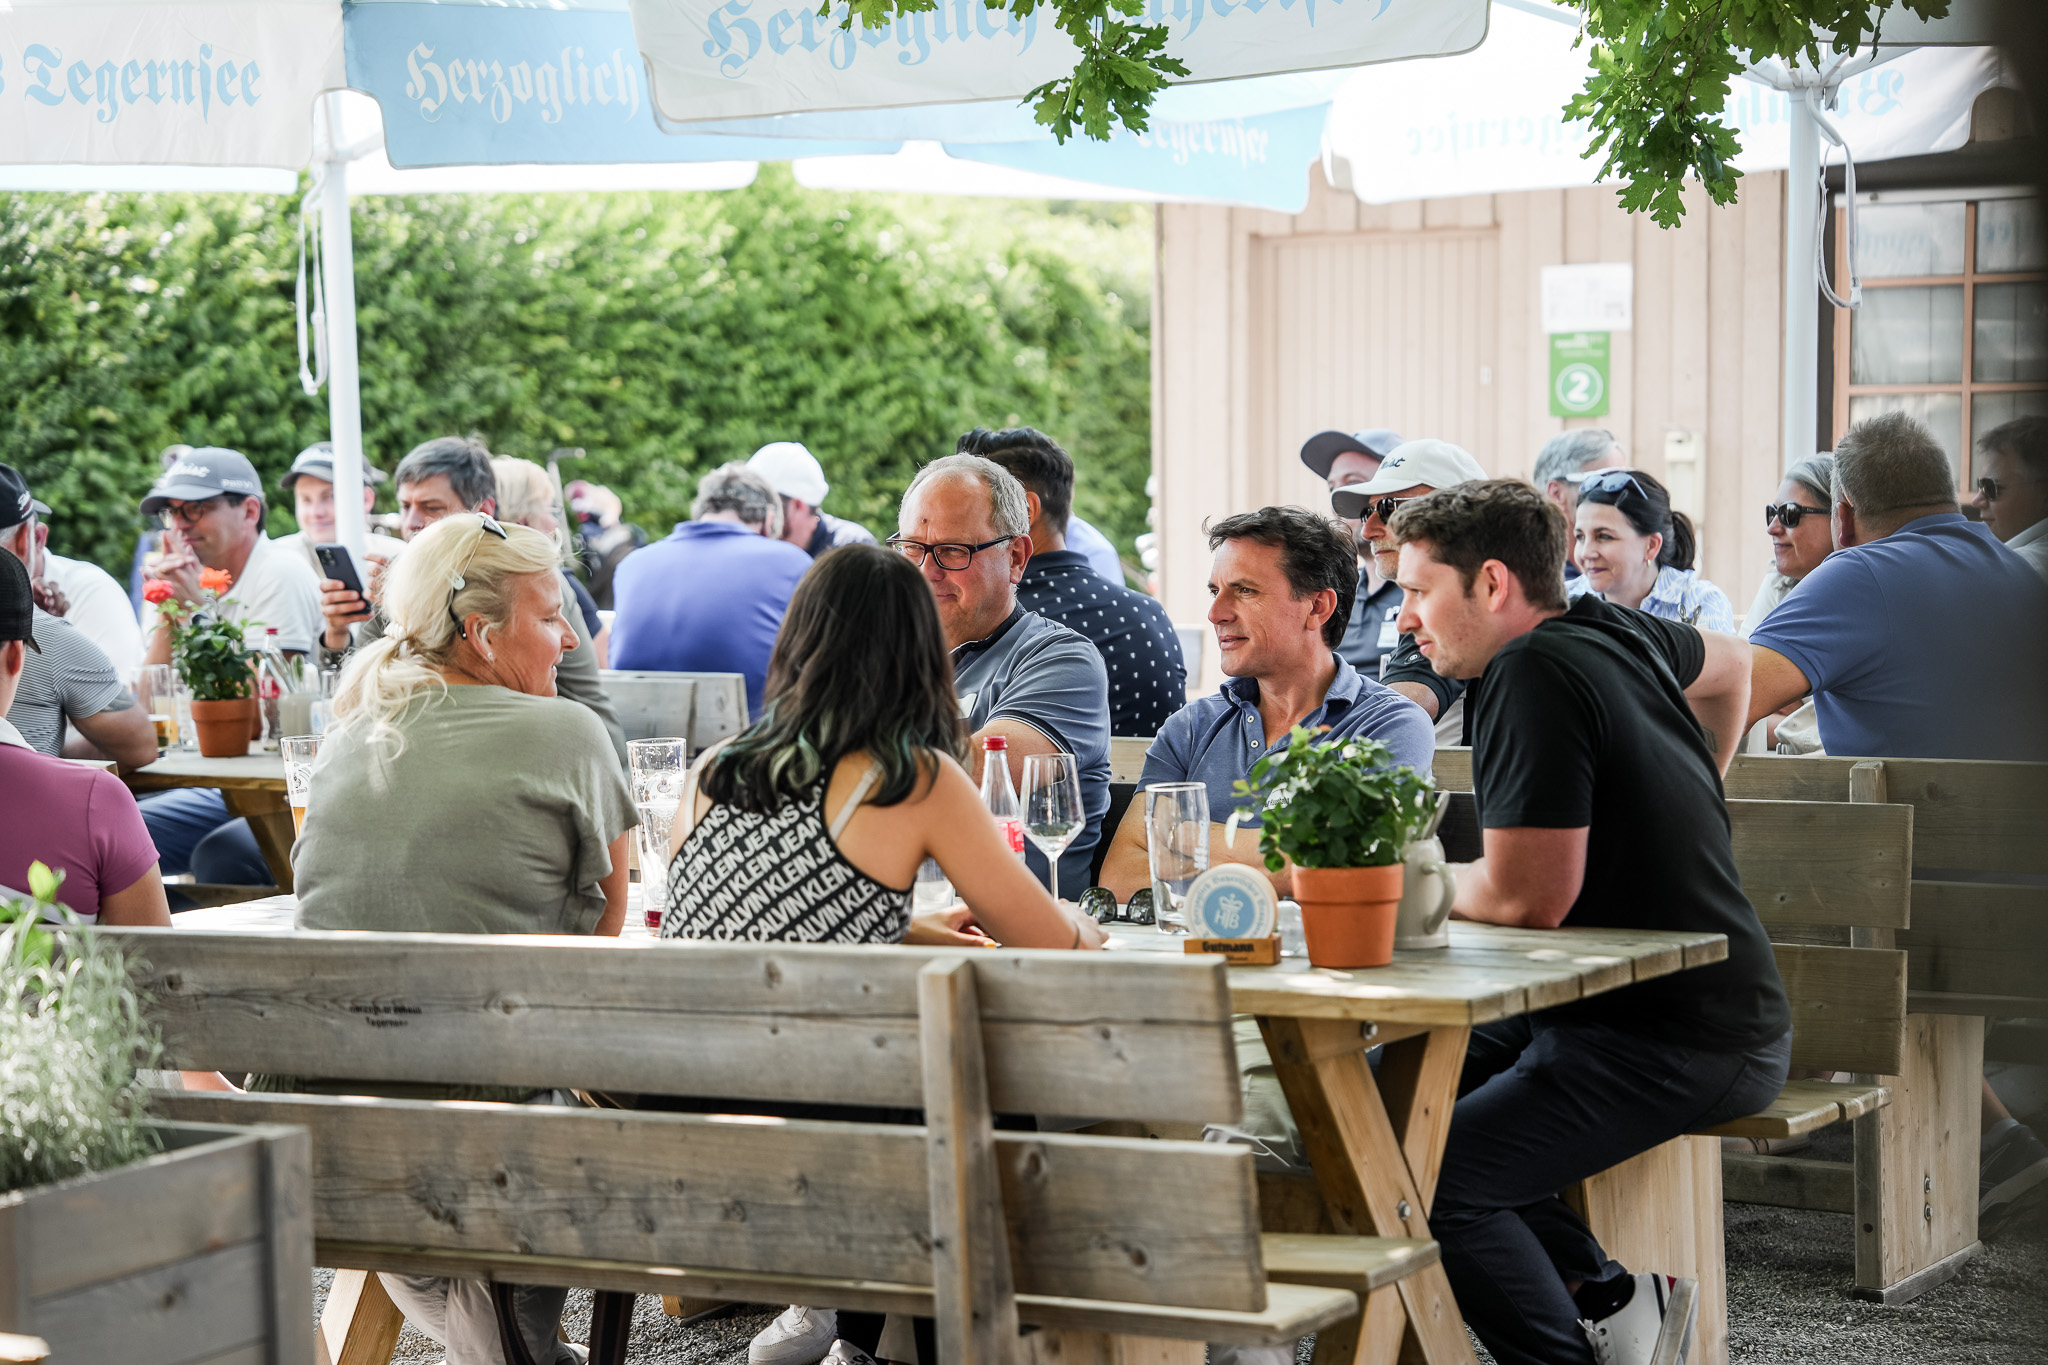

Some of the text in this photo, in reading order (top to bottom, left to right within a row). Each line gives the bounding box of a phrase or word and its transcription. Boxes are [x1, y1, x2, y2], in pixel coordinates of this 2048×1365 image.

[24, 43, 262, 125] Tegernsee
[406, 41, 640, 124] Herzoglich
[1566, 371, 1591, 403] 2
[674, 847, 713, 901] KLEIN
[682, 885, 736, 939] CALVIN
[728, 846, 781, 898] KLEIN
[779, 811, 823, 859] JEAN
[698, 846, 745, 898] KLEIN
[743, 804, 800, 858] JEANS
[712, 885, 771, 941] CALVIN
[762, 849, 818, 899] KLEIN
[747, 889, 809, 942] CALVIN
[800, 862, 855, 906] KLEIN
[1202, 941, 1255, 952] Gutmann
